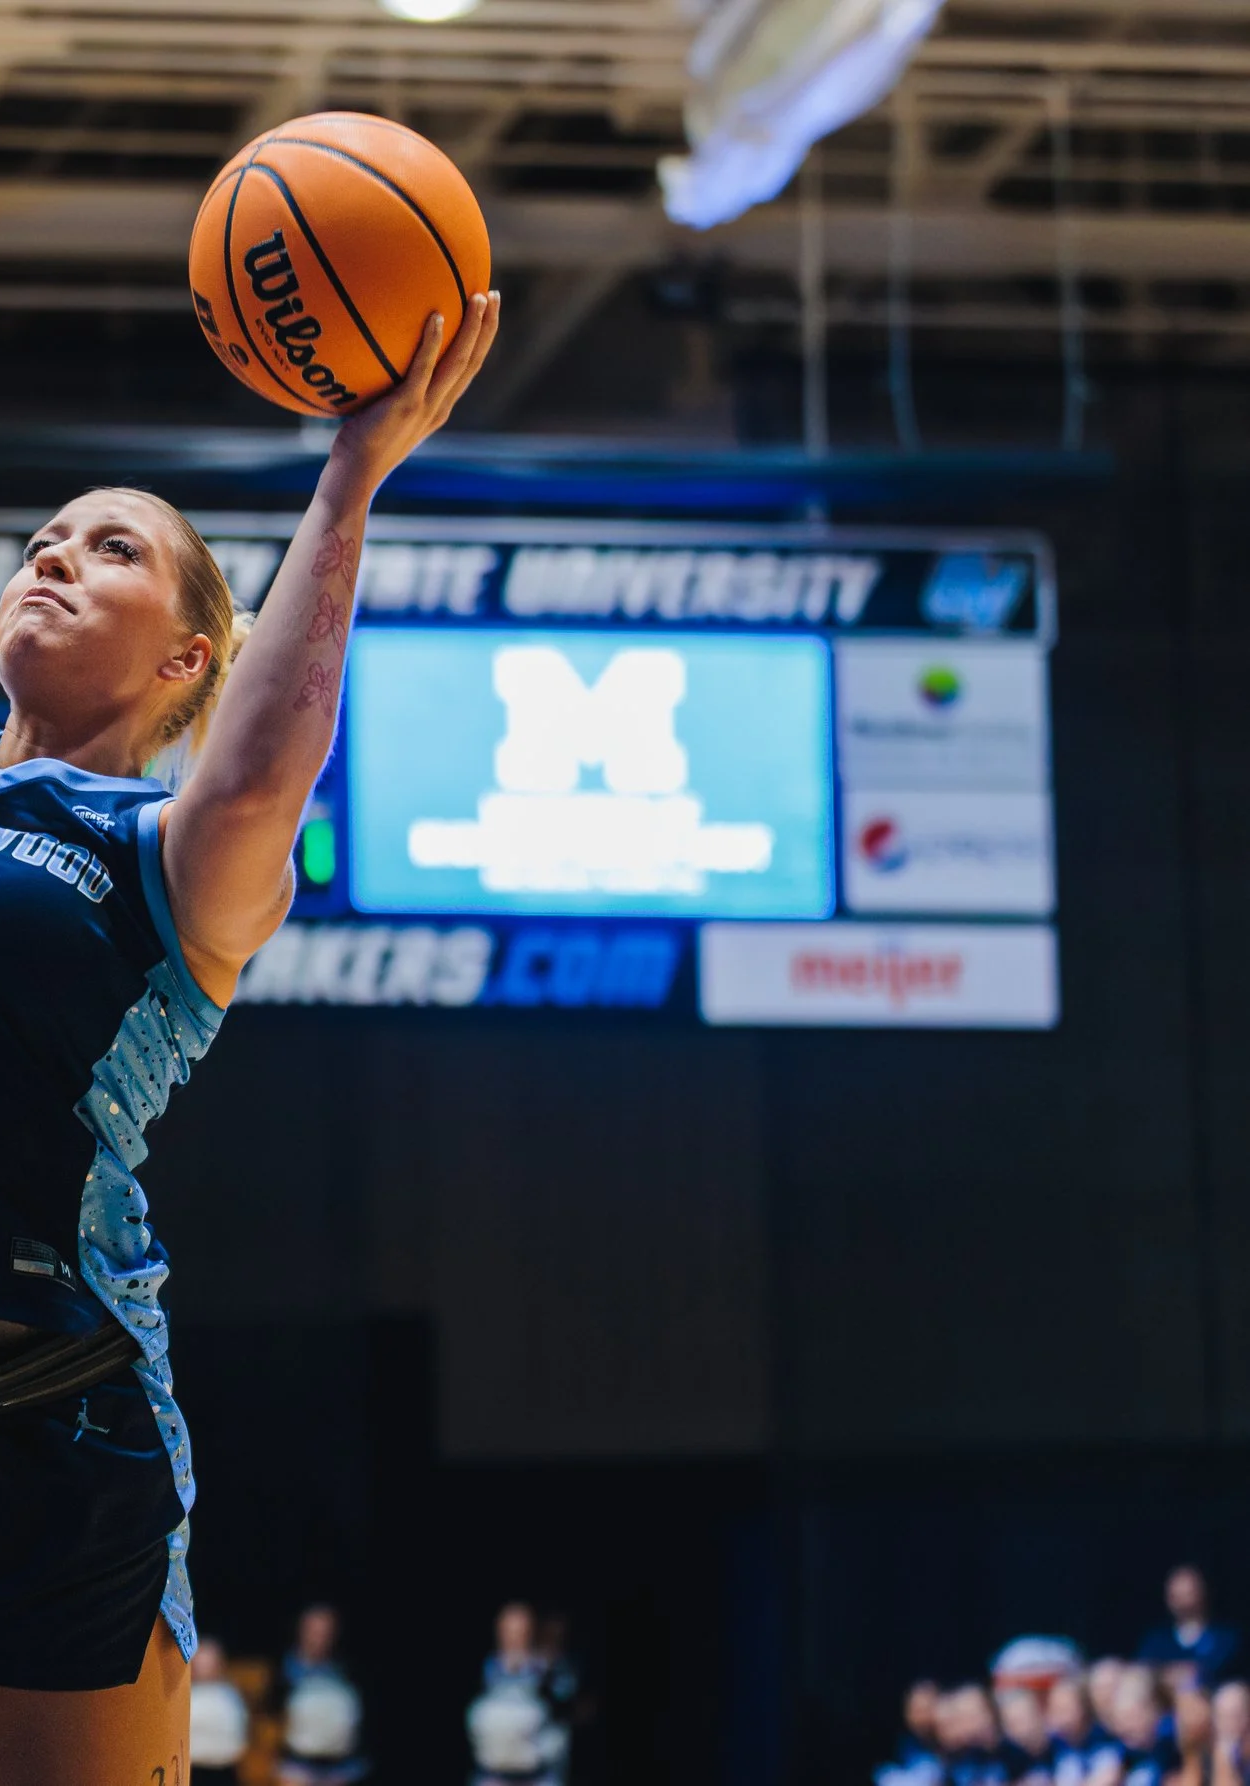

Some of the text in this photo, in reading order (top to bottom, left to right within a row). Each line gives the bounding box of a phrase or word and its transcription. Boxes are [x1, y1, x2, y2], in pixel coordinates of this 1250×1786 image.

[244, 228, 358, 408] Wilson
[502, 545, 879, 622] UNIVERSITY
[239, 924, 681, 1007] AKERS.COM
[791, 943, 964, 1011] meijer
